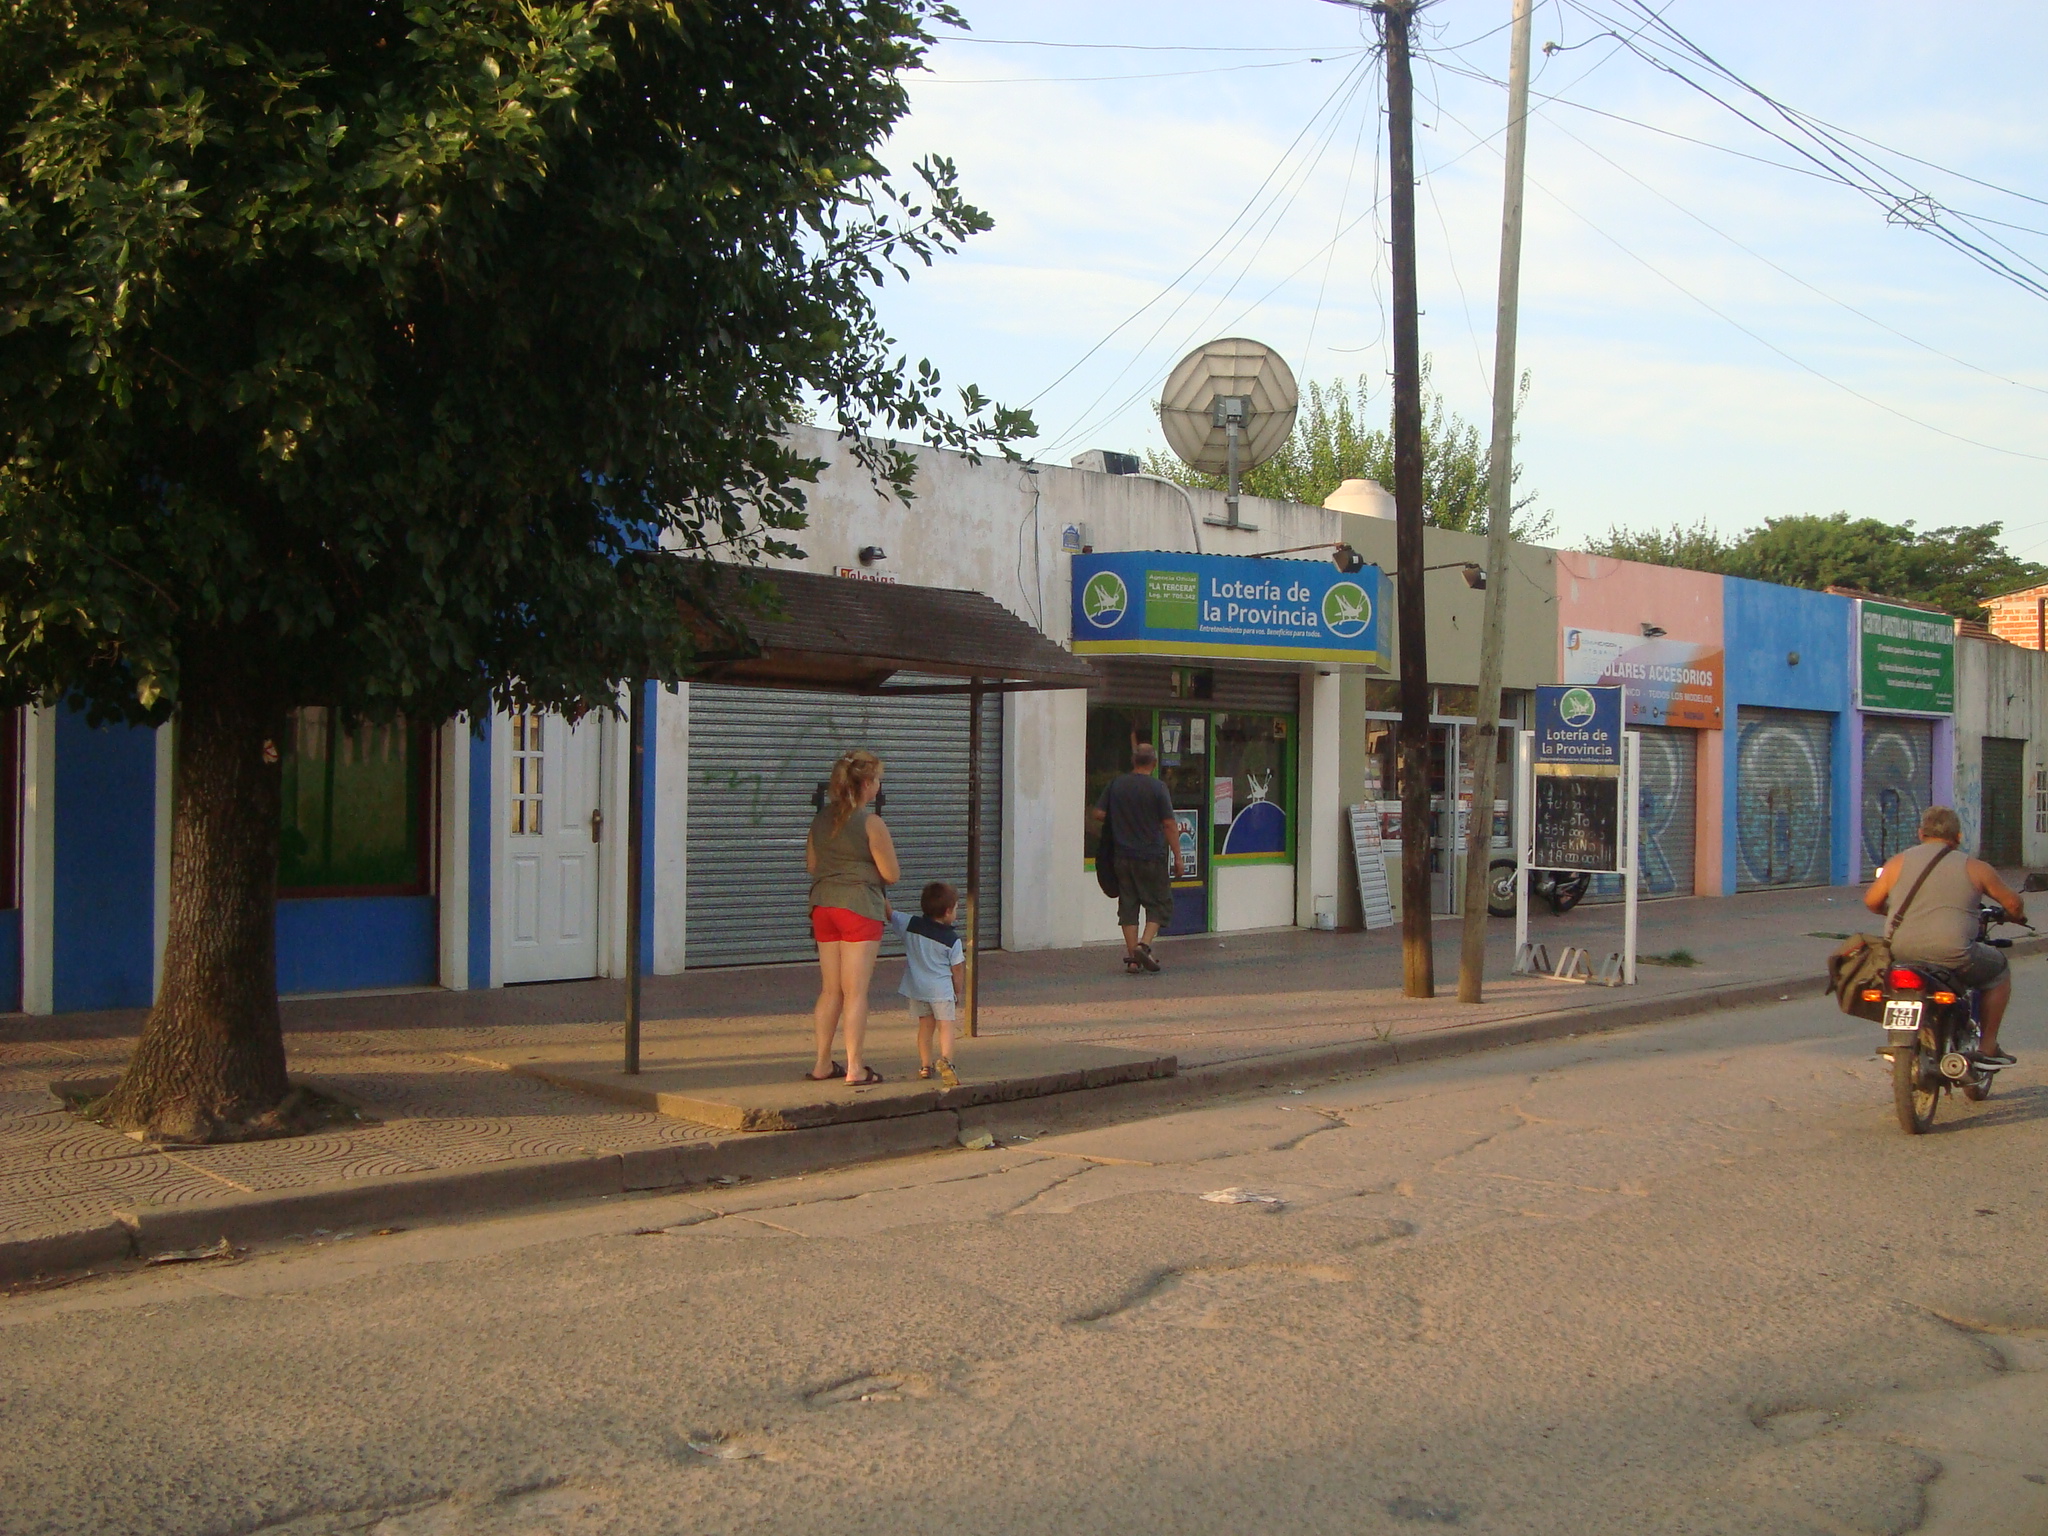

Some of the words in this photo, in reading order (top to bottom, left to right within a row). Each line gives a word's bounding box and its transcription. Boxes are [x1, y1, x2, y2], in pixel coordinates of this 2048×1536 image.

[1211, 577, 1281, 601] Lotería
[1286, 581, 1311, 602] de
[1203, 600, 1221, 622] la
[1228, 603, 1318, 627] Provincia
[1648, 666, 1713, 687] ACCESORIOS
[1625, 688, 1641, 697] NICO
[1648, 689, 1670, 699] TODOS
[1671, 691, 1684, 701] LOS
[1684, 693, 1713, 704] MODELOS
[1546, 728, 1589, 741] Lotería
[1592, 729, 1608, 741] de
[1542, 742, 1553, 754] la
[1556, 743, 1612, 755] Provincia
